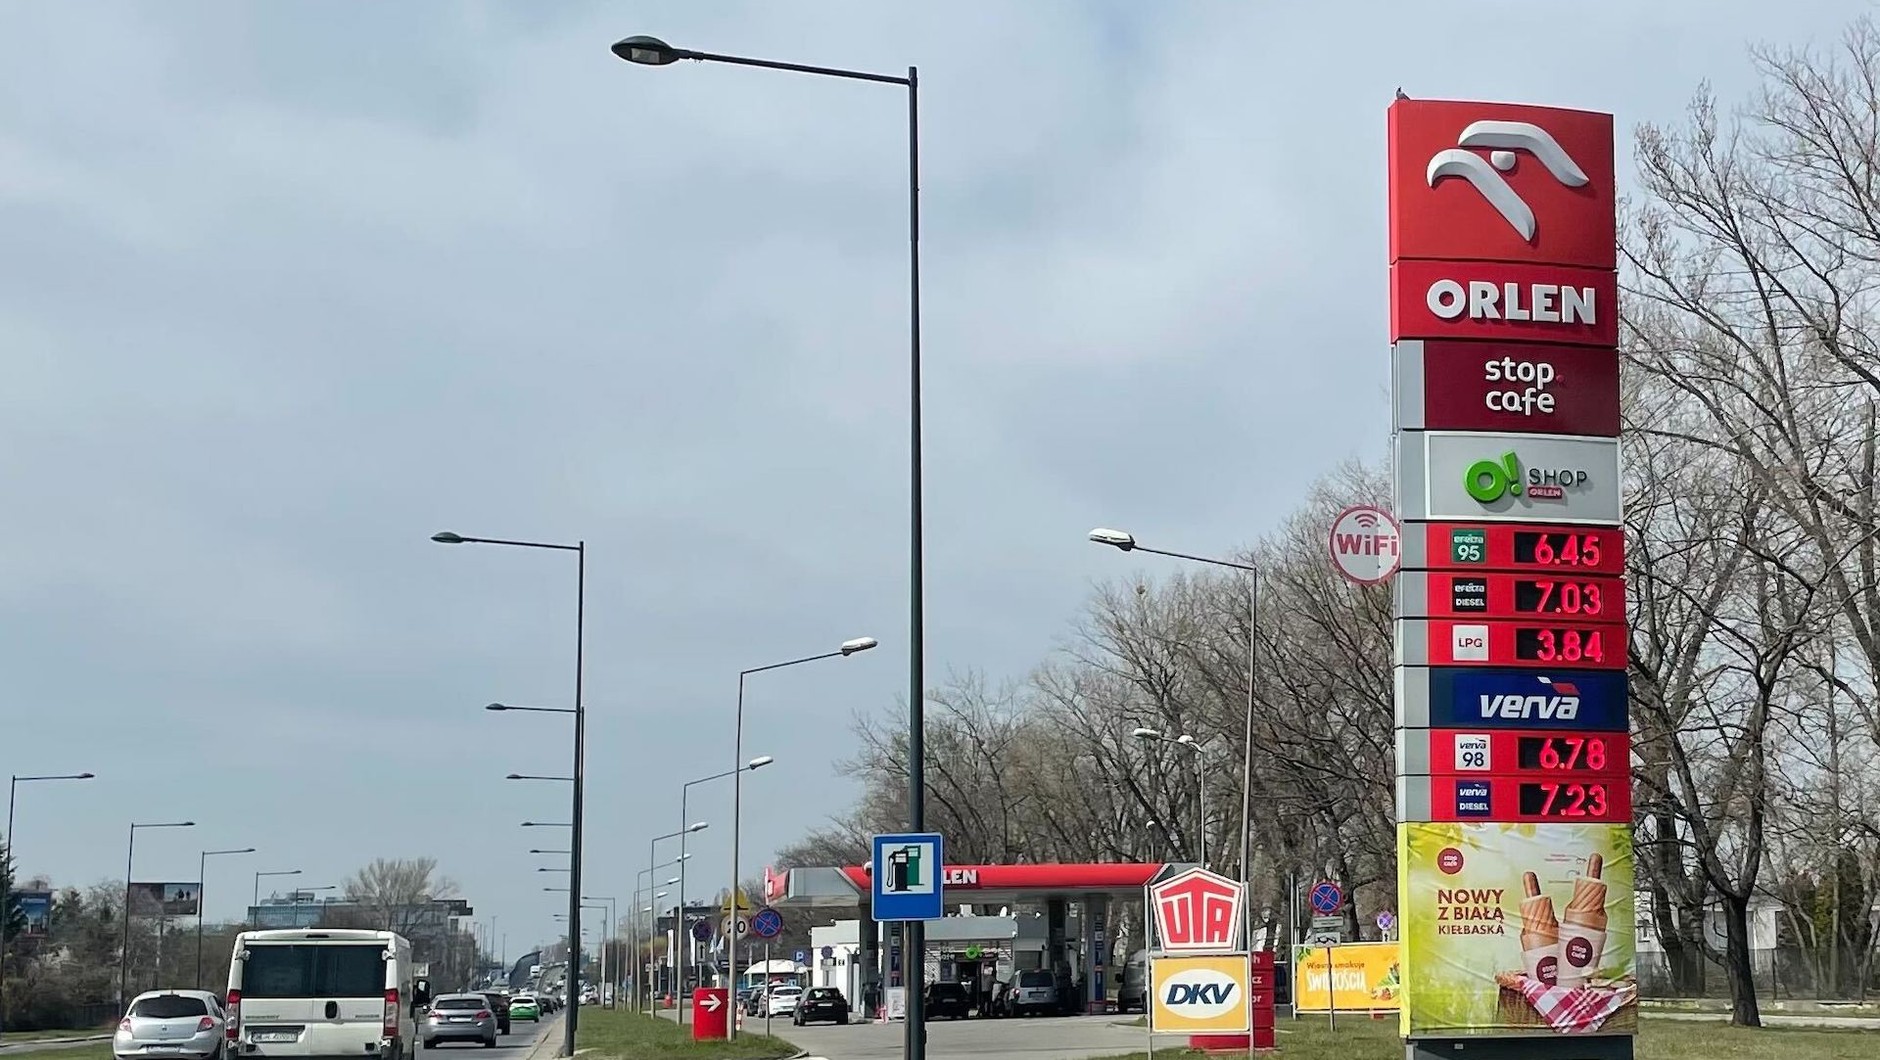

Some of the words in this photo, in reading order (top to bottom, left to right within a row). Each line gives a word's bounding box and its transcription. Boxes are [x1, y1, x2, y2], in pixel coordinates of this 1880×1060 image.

[1426, 279, 1596, 325] ORLEN
[1485, 356, 1554, 389] stop
[1486, 387, 1555, 415] cafe
[1529, 468, 1588, 487] SHOP
[1529, 488, 1561, 497] ORLEN
[1336, 533, 1397, 556] WiFi
[1457, 545, 1480, 561] 95
[1534, 534, 1600, 566] 6.45
[1456, 598, 1485, 606] DIESEL
[1535, 582, 1601, 615] 7.03
[1458, 638, 1483, 648] LPG
[1537, 629, 1602, 662] 3.84
[1480, 693, 1580, 720] verva
[1459, 740, 1486, 749] verva
[1539, 738, 1605, 769] 6.78
[1463, 752, 1484, 767] 98
[1459, 787, 1487, 796] verva
[1540, 784, 1607, 817] 7.23
[1459, 802, 1488, 811] DIESEL
[1437, 888, 1505, 905] NOWY
[1159, 877, 1236, 943] UTA
[1437, 906, 1449, 920] Z
[1454, 906, 1505, 924] BIAŁĄ
[1438, 925, 1505, 936] KIEŁBASKĄ
[1335, 960, 1365, 970] smakuje
[1165, 982, 1236, 1005] DKV
